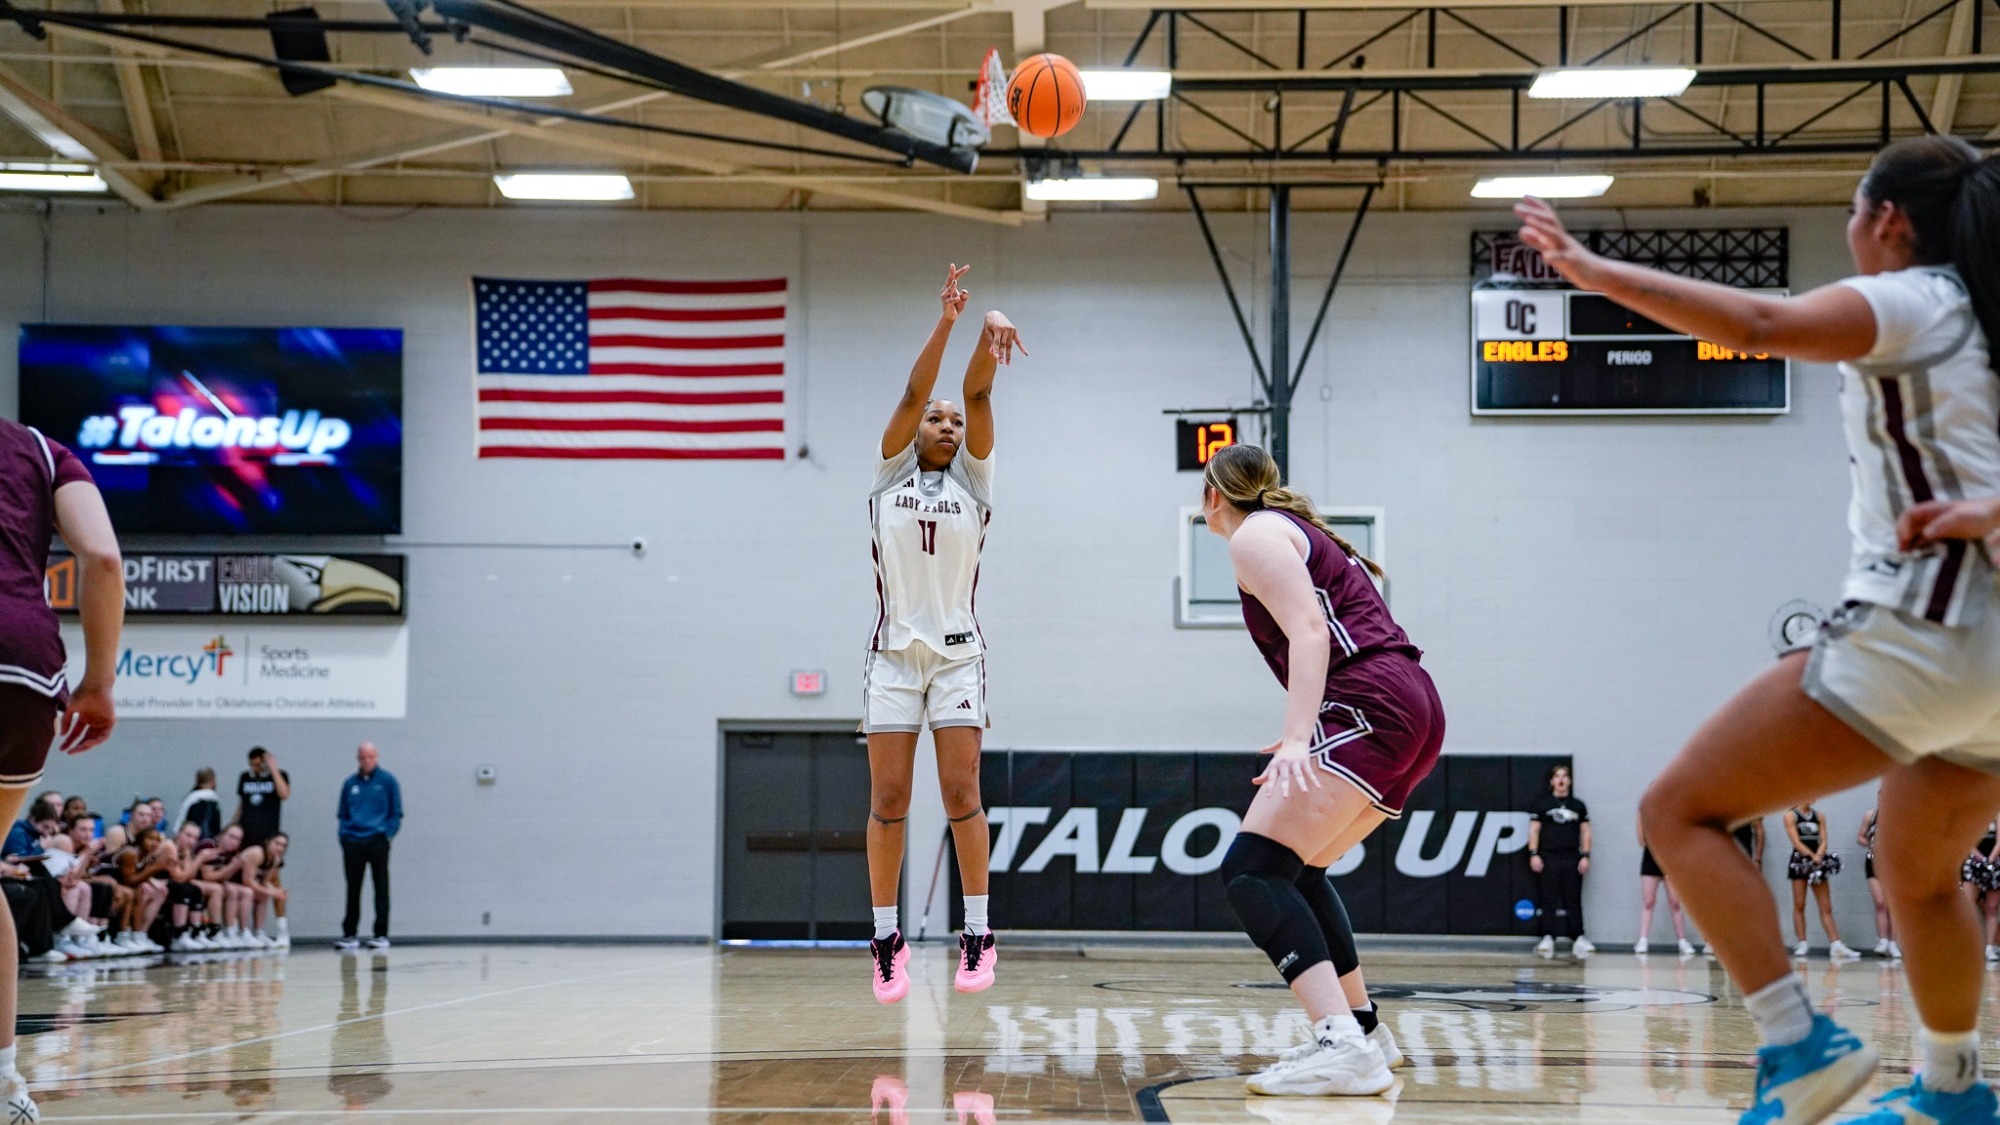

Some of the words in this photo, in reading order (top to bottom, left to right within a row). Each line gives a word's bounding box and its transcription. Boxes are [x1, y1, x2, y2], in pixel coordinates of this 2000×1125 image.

[1505, 299, 1536, 335] OC
[1484, 341, 1568, 362] EAGLES
[1607, 350, 1653, 365] PERIOD
[78, 405, 350, 455] #TalonsUp
[1197, 424, 1233, 463] 12
[895, 494, 921, 511] LADY
[917, 519, 937, 555] 11
[218, 583, 289, 613] VISION
[261, 645, 308, 662] Sports
[260, 664, 329, 679] Medicine
[148, 696, 192, 707] Provider
[196, 696, 211, 707] for
[215, 696, 272, 708] Oklahoma
[985, 806, 1365, 876] TALO
[1395, 810, 1530, 877] UP
